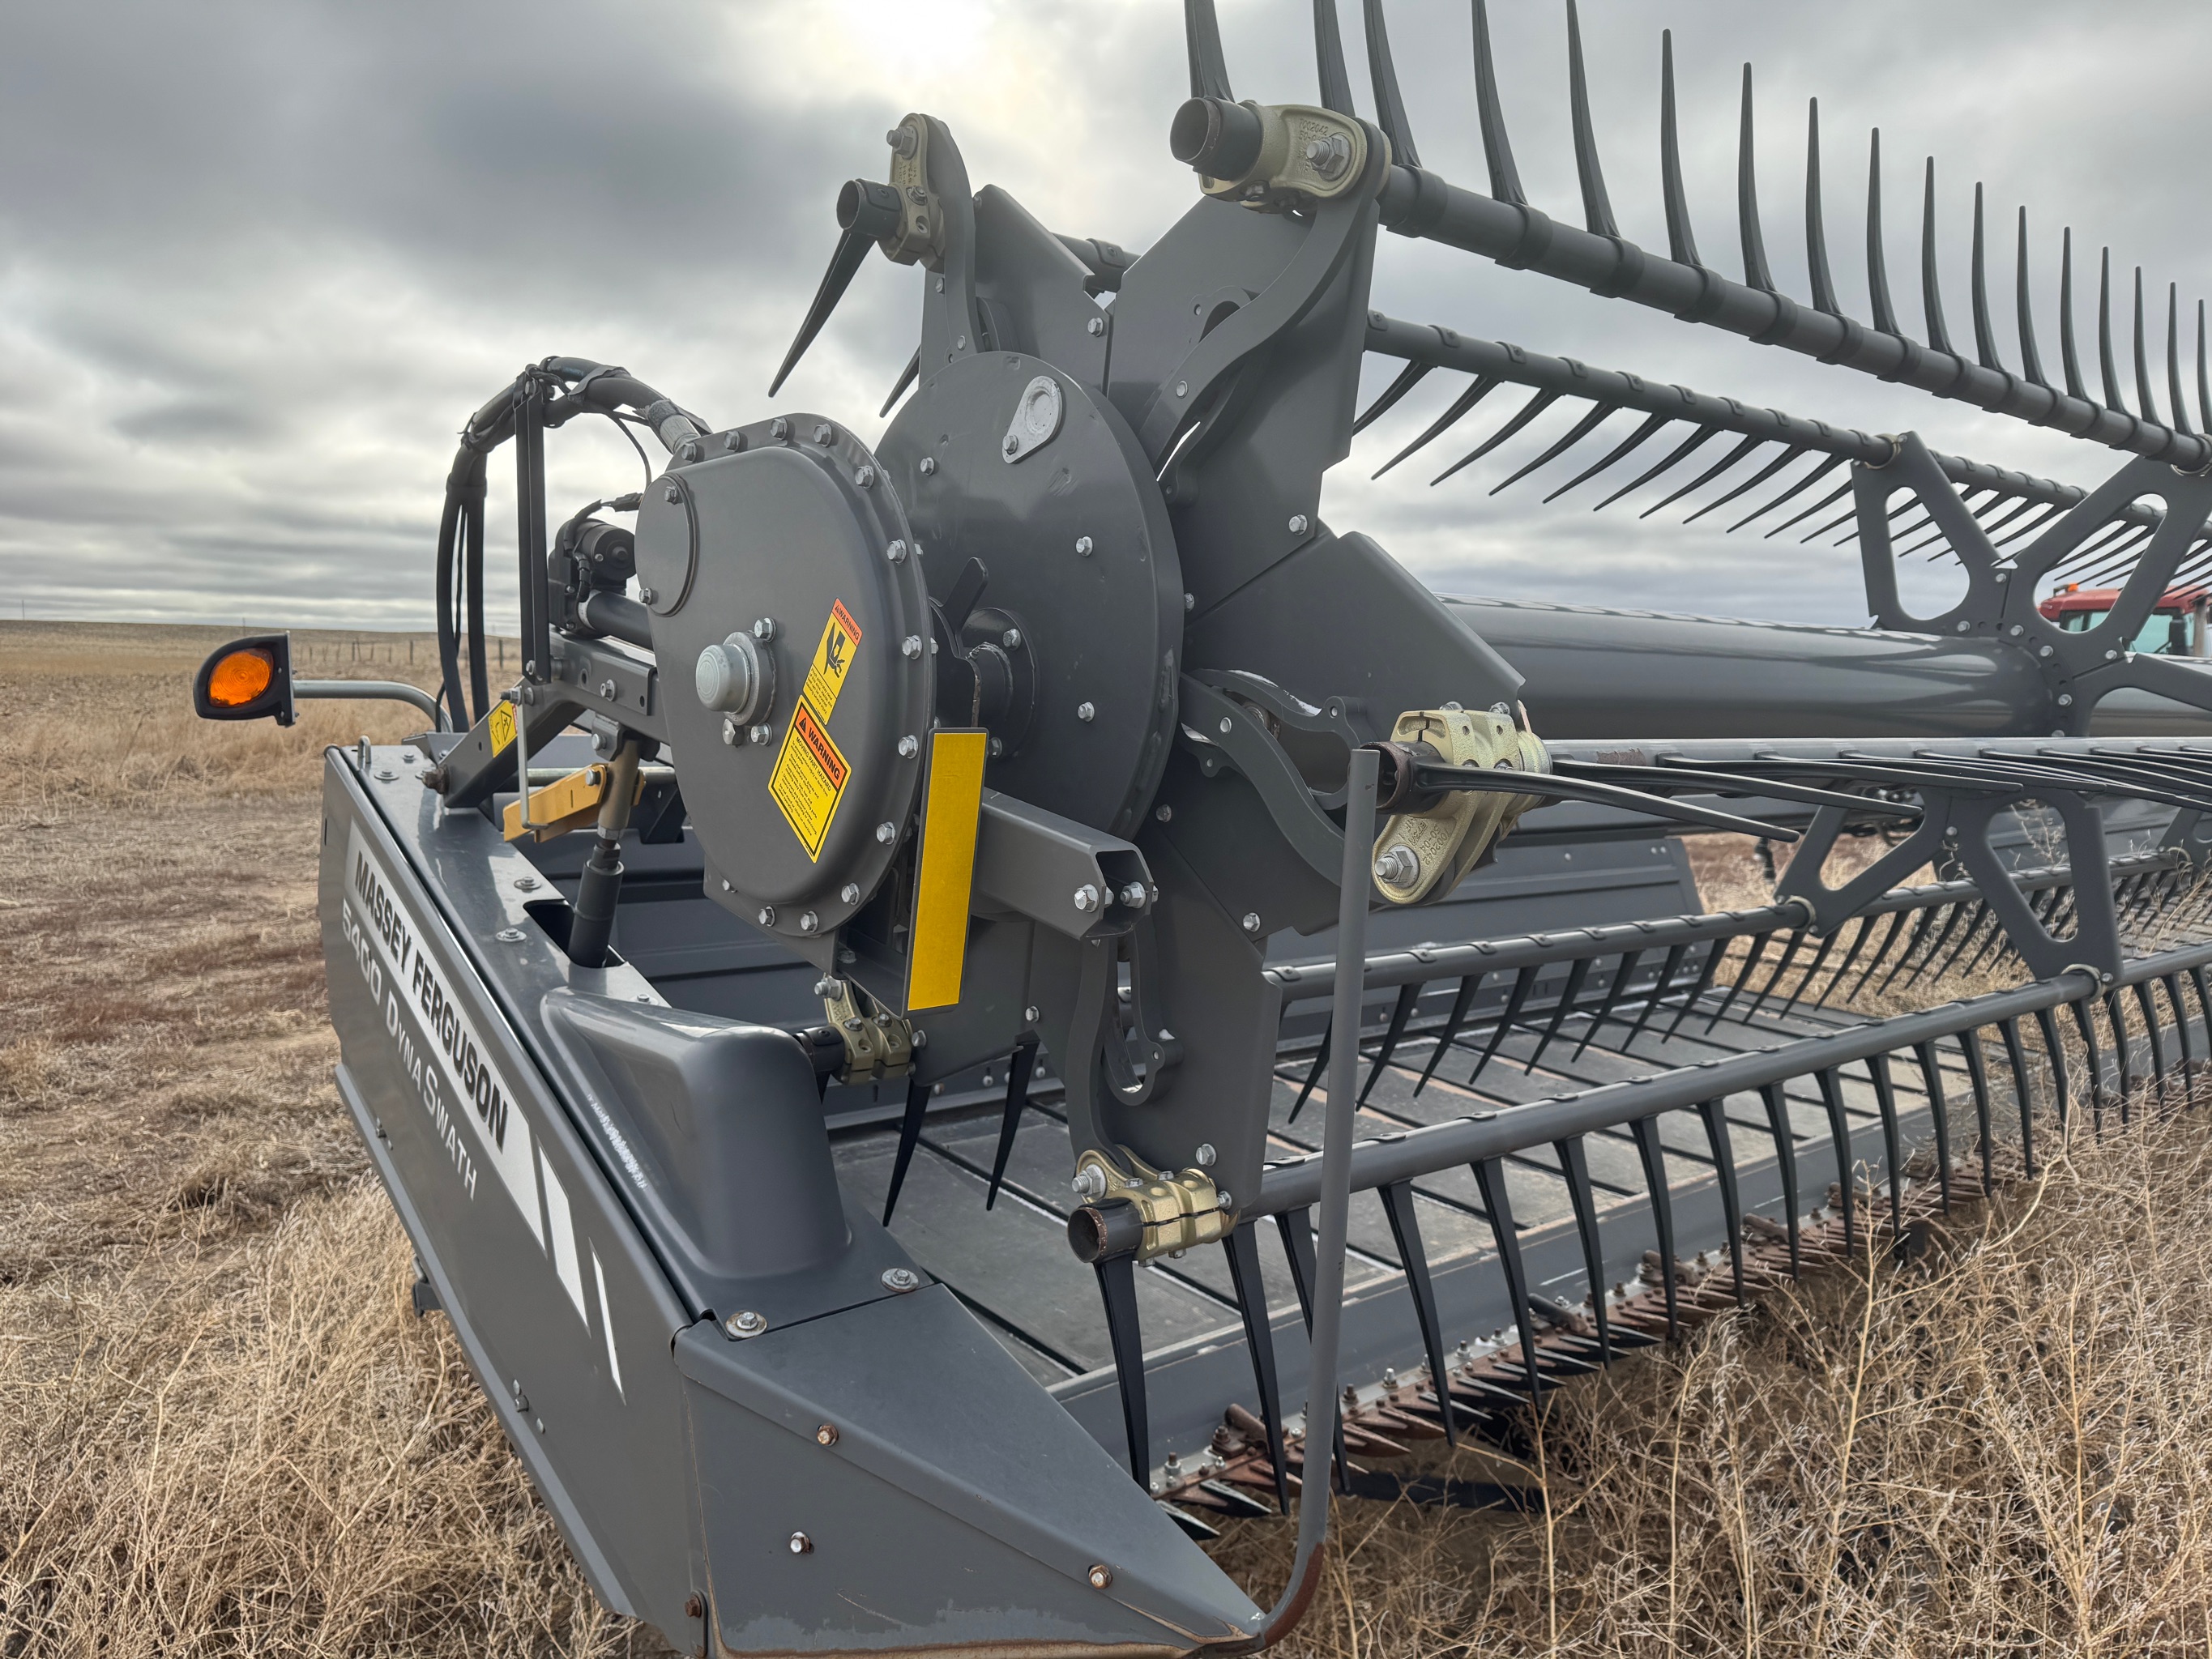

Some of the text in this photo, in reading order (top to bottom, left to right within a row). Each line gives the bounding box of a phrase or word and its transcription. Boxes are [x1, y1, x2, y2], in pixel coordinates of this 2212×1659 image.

[839, 608, 860, 641] WARNING
[796, 736, 809, 757] MOVING
[809, 756, 818, 770] PART
[817, 769, 831, 791] HAZARD
[809, 727, 840, 780] WARNING
[1423, 827, 1449, 864] 7002042
[342, 898, 382, 1005] 5400
[355, 850, 509, 1154] MASSEY FERGUSON
